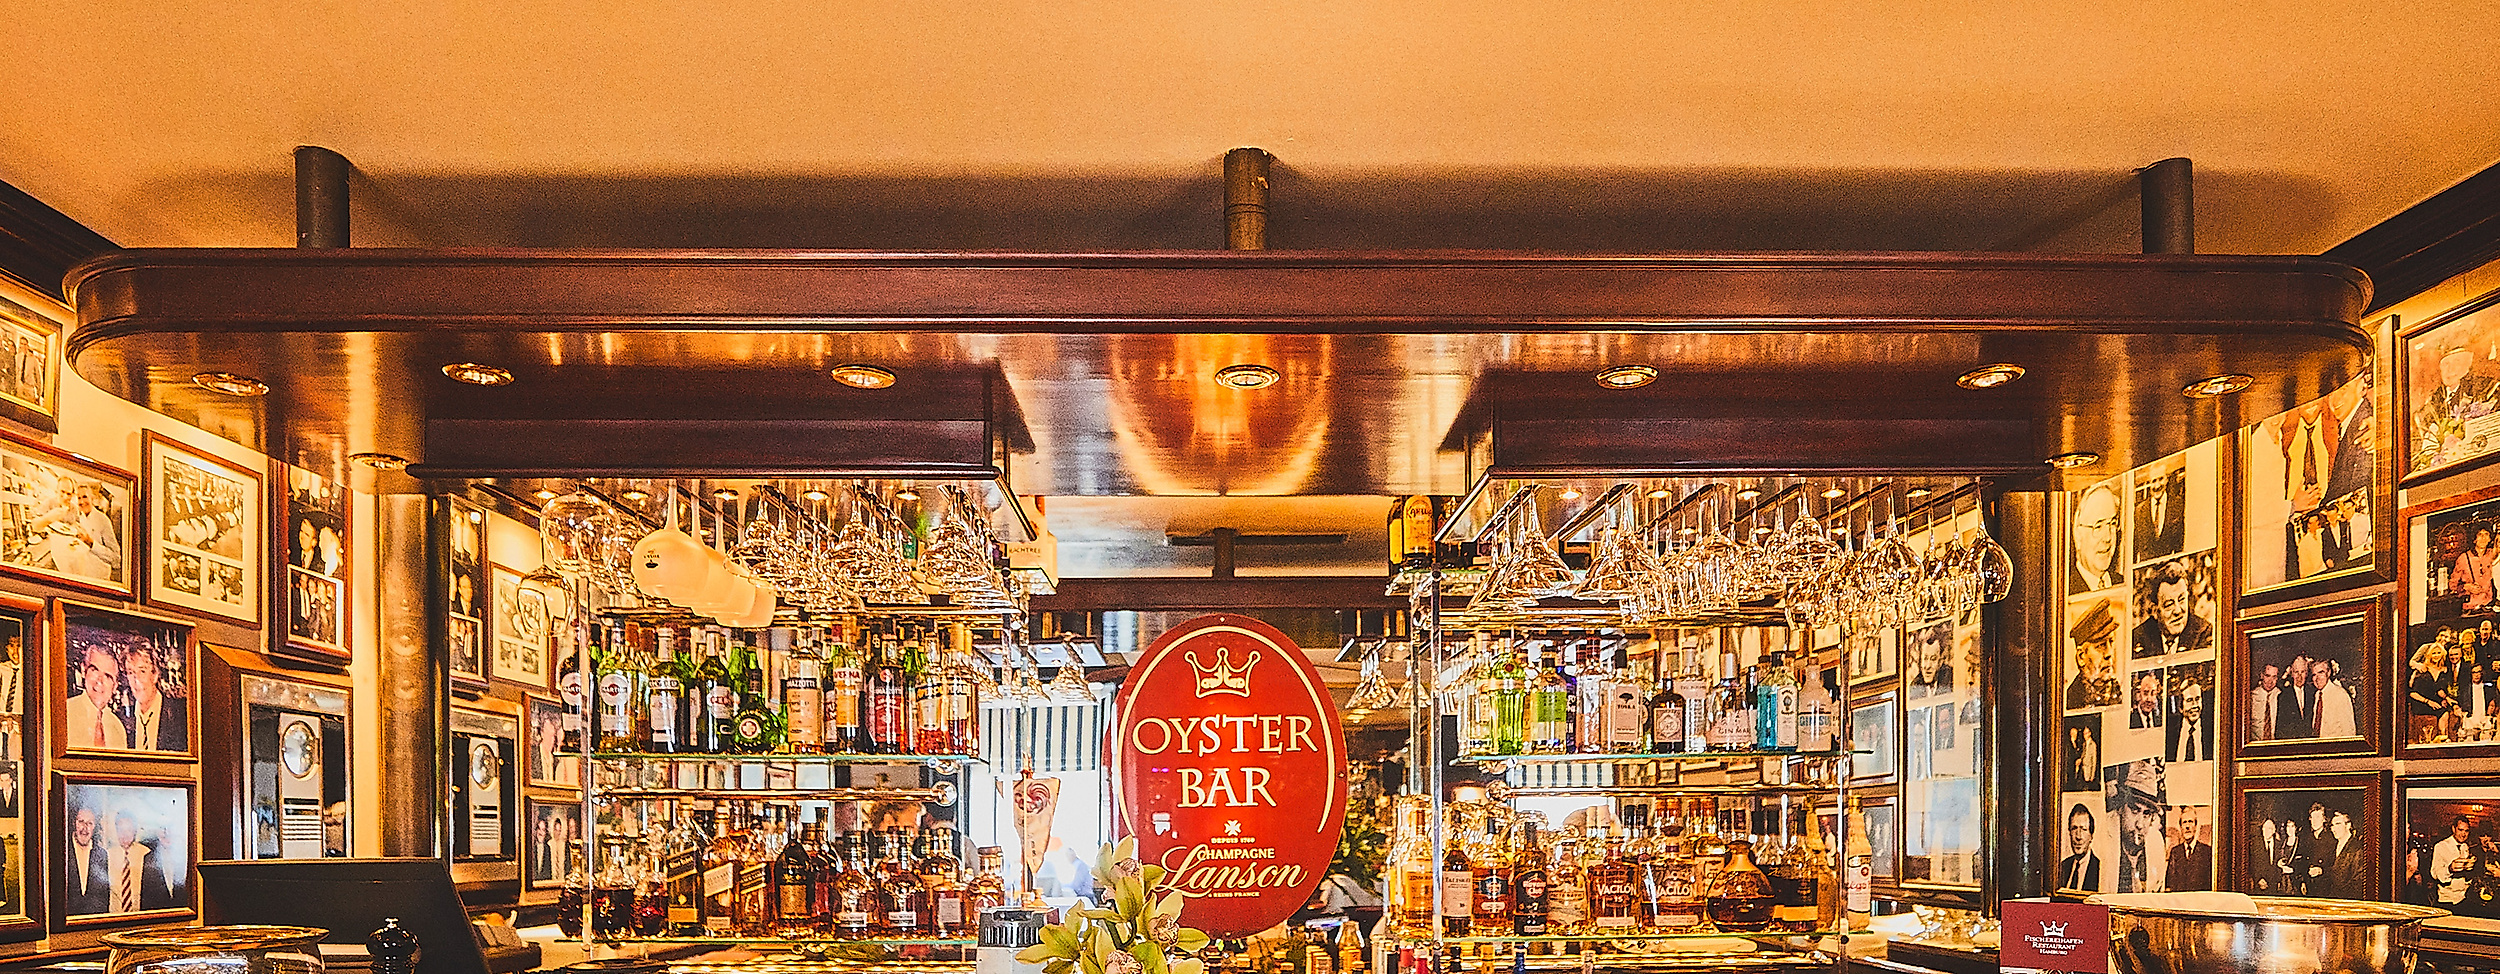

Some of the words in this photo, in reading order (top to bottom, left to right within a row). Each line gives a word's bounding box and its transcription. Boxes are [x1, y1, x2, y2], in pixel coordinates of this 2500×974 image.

[1132, 714, 1319, 757] OYSTER
[1176, 767, 1277, 808] BAR
[1197, 848, 1275, 860] CHAMPAGNE
[1153, 845, 1308, 898] Lanson
[1596, 882, 1637, 896] VACILÓN
[2032, 942, 2076, 950] RESTAURANT
